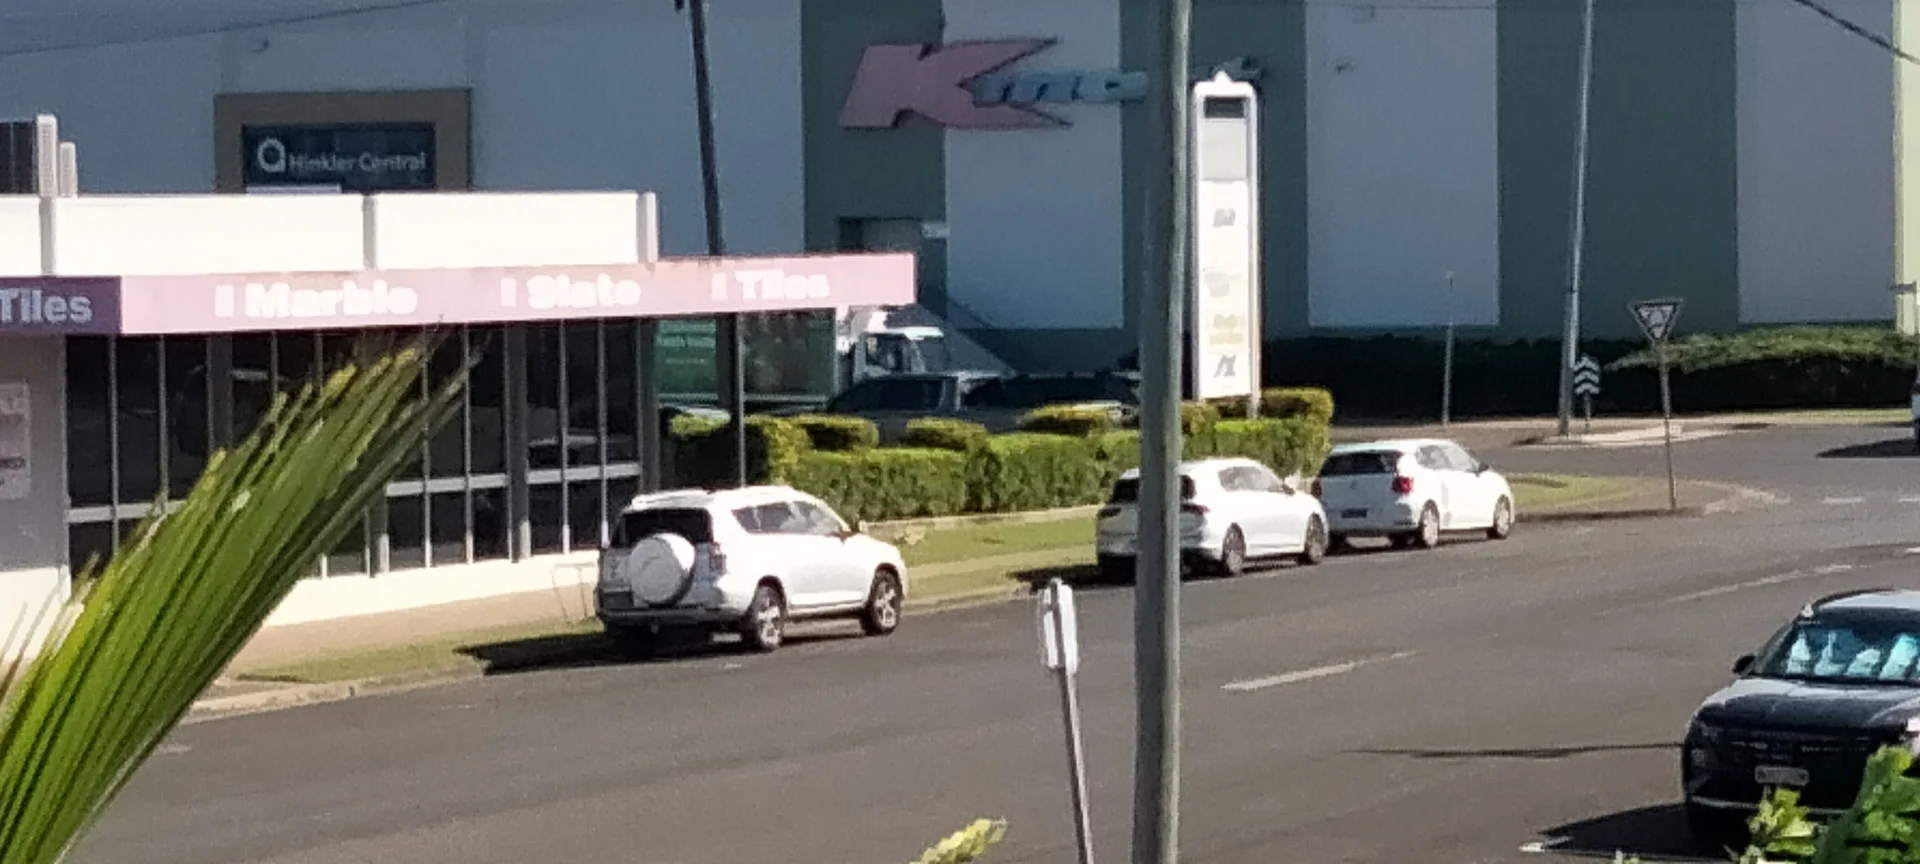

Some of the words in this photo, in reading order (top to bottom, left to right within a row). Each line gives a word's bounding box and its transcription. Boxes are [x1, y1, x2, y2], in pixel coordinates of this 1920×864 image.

[288, 152, 355, 172] Hinkler
[358, 151, 427, 172] Central
[0, 287, 93, 324] Tiles
